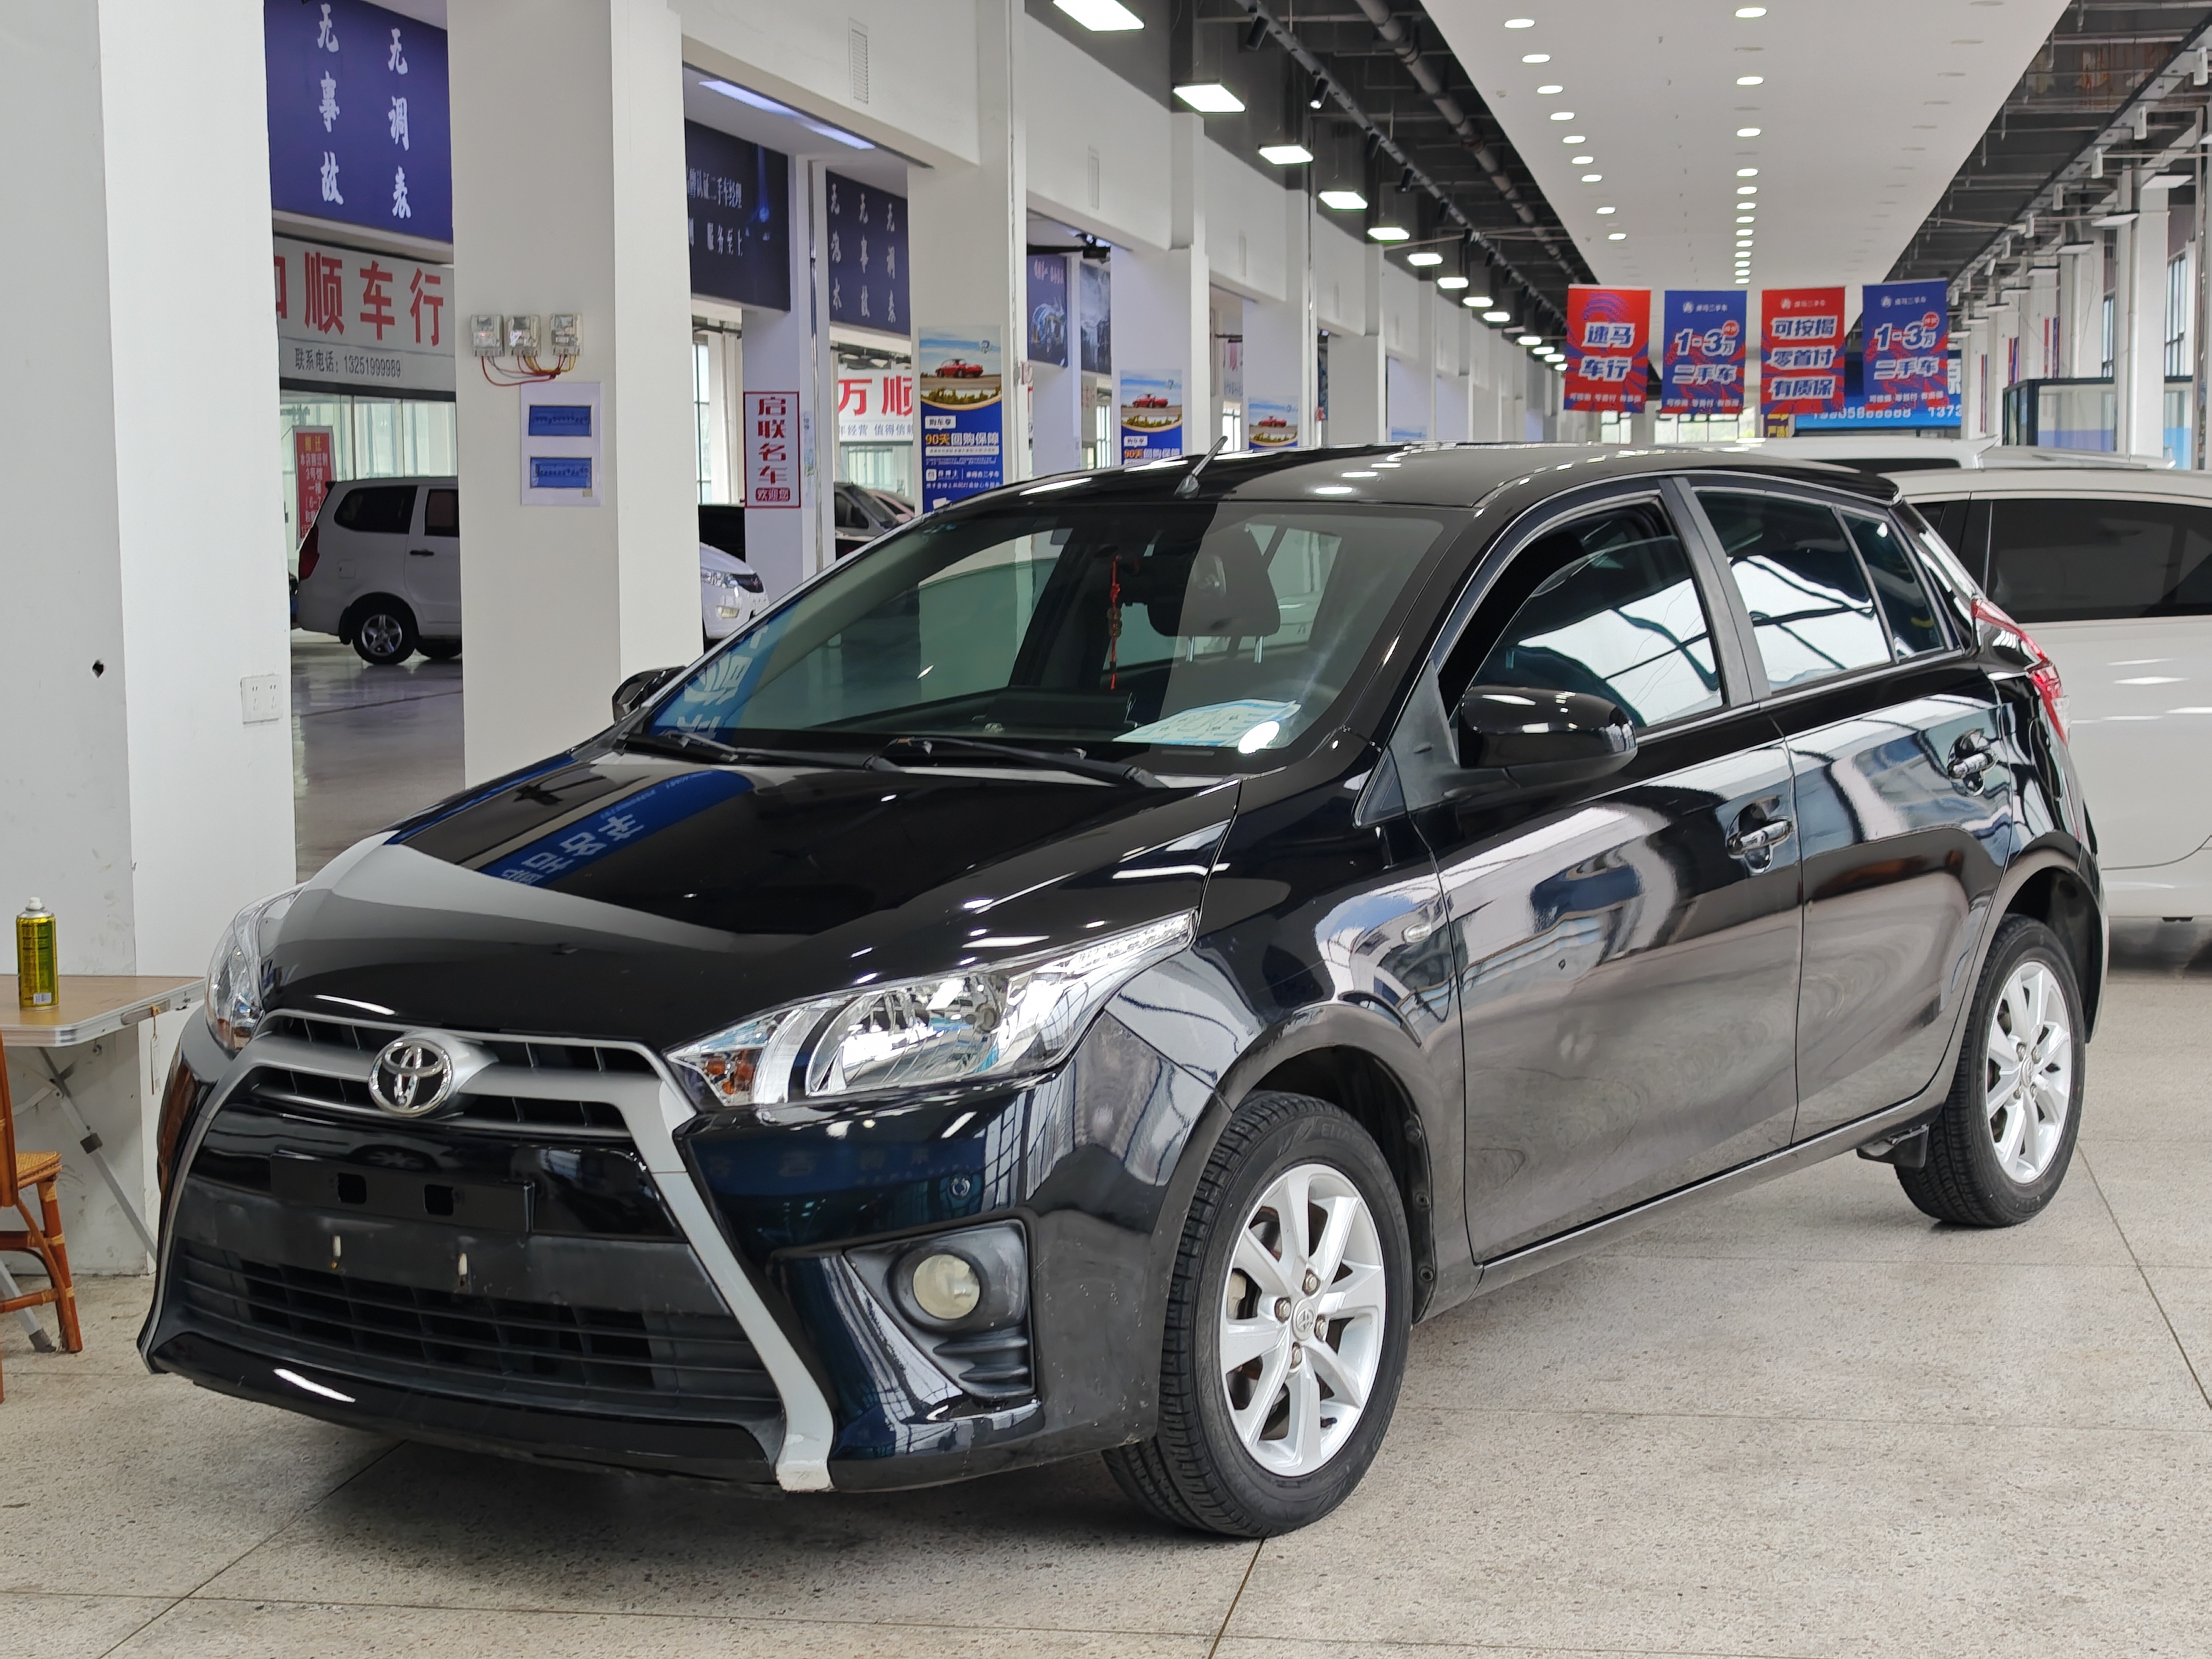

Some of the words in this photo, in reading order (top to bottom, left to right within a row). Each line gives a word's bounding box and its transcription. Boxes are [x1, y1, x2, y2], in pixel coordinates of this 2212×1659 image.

[317, 3, 344, 205] 无事故
[388, 28, 412, 219] 无调表
[1580, 358, 1630, 380] 车行
